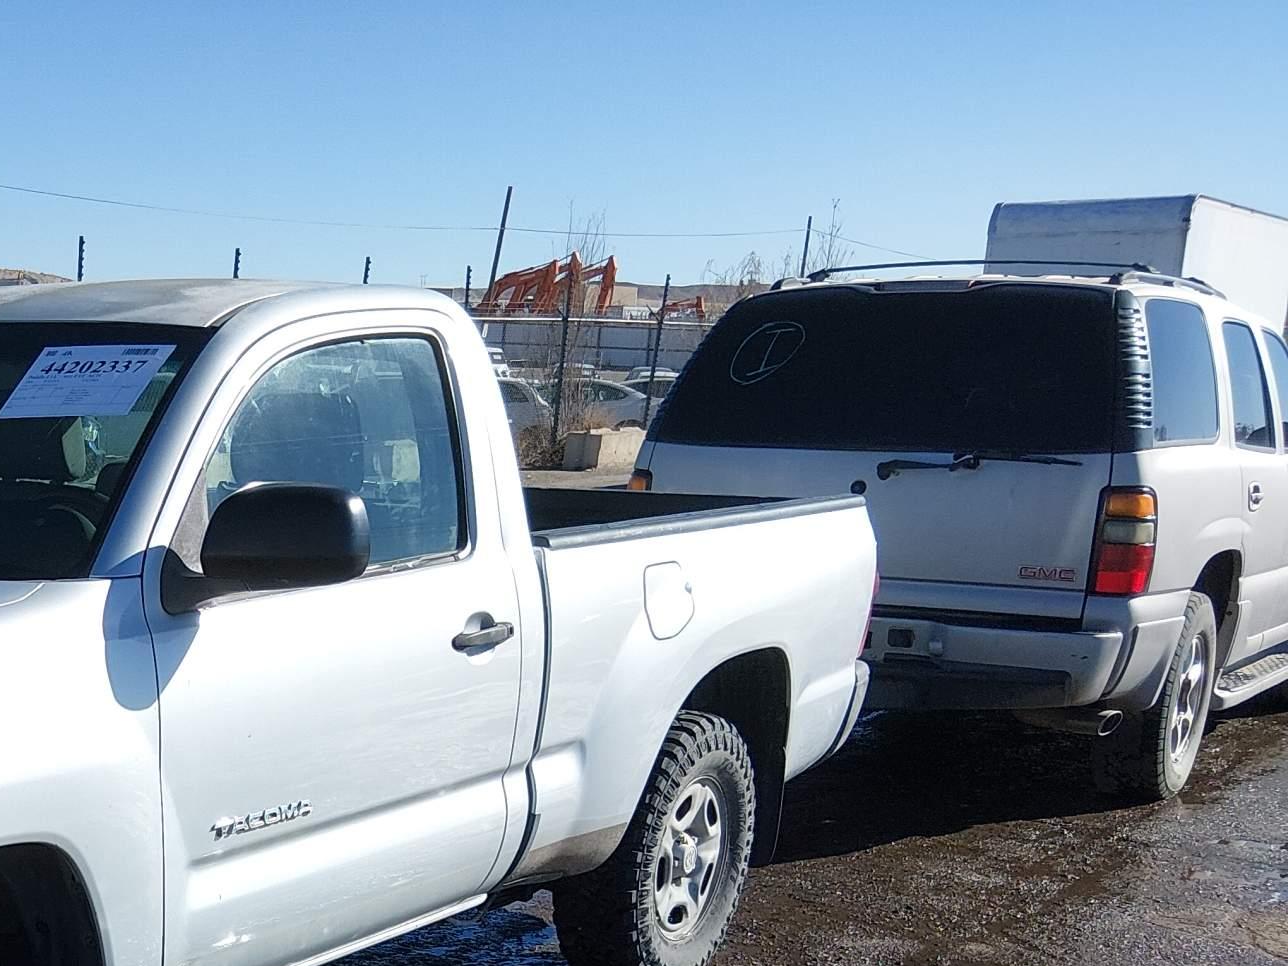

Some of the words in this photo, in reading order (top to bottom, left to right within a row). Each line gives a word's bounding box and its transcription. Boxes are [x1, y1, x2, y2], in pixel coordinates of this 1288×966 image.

[40, 359, 150, 375] 44202337
[1018, 566, 1075, 581] GMC
[210, 799, 312, 841] TACOMA
